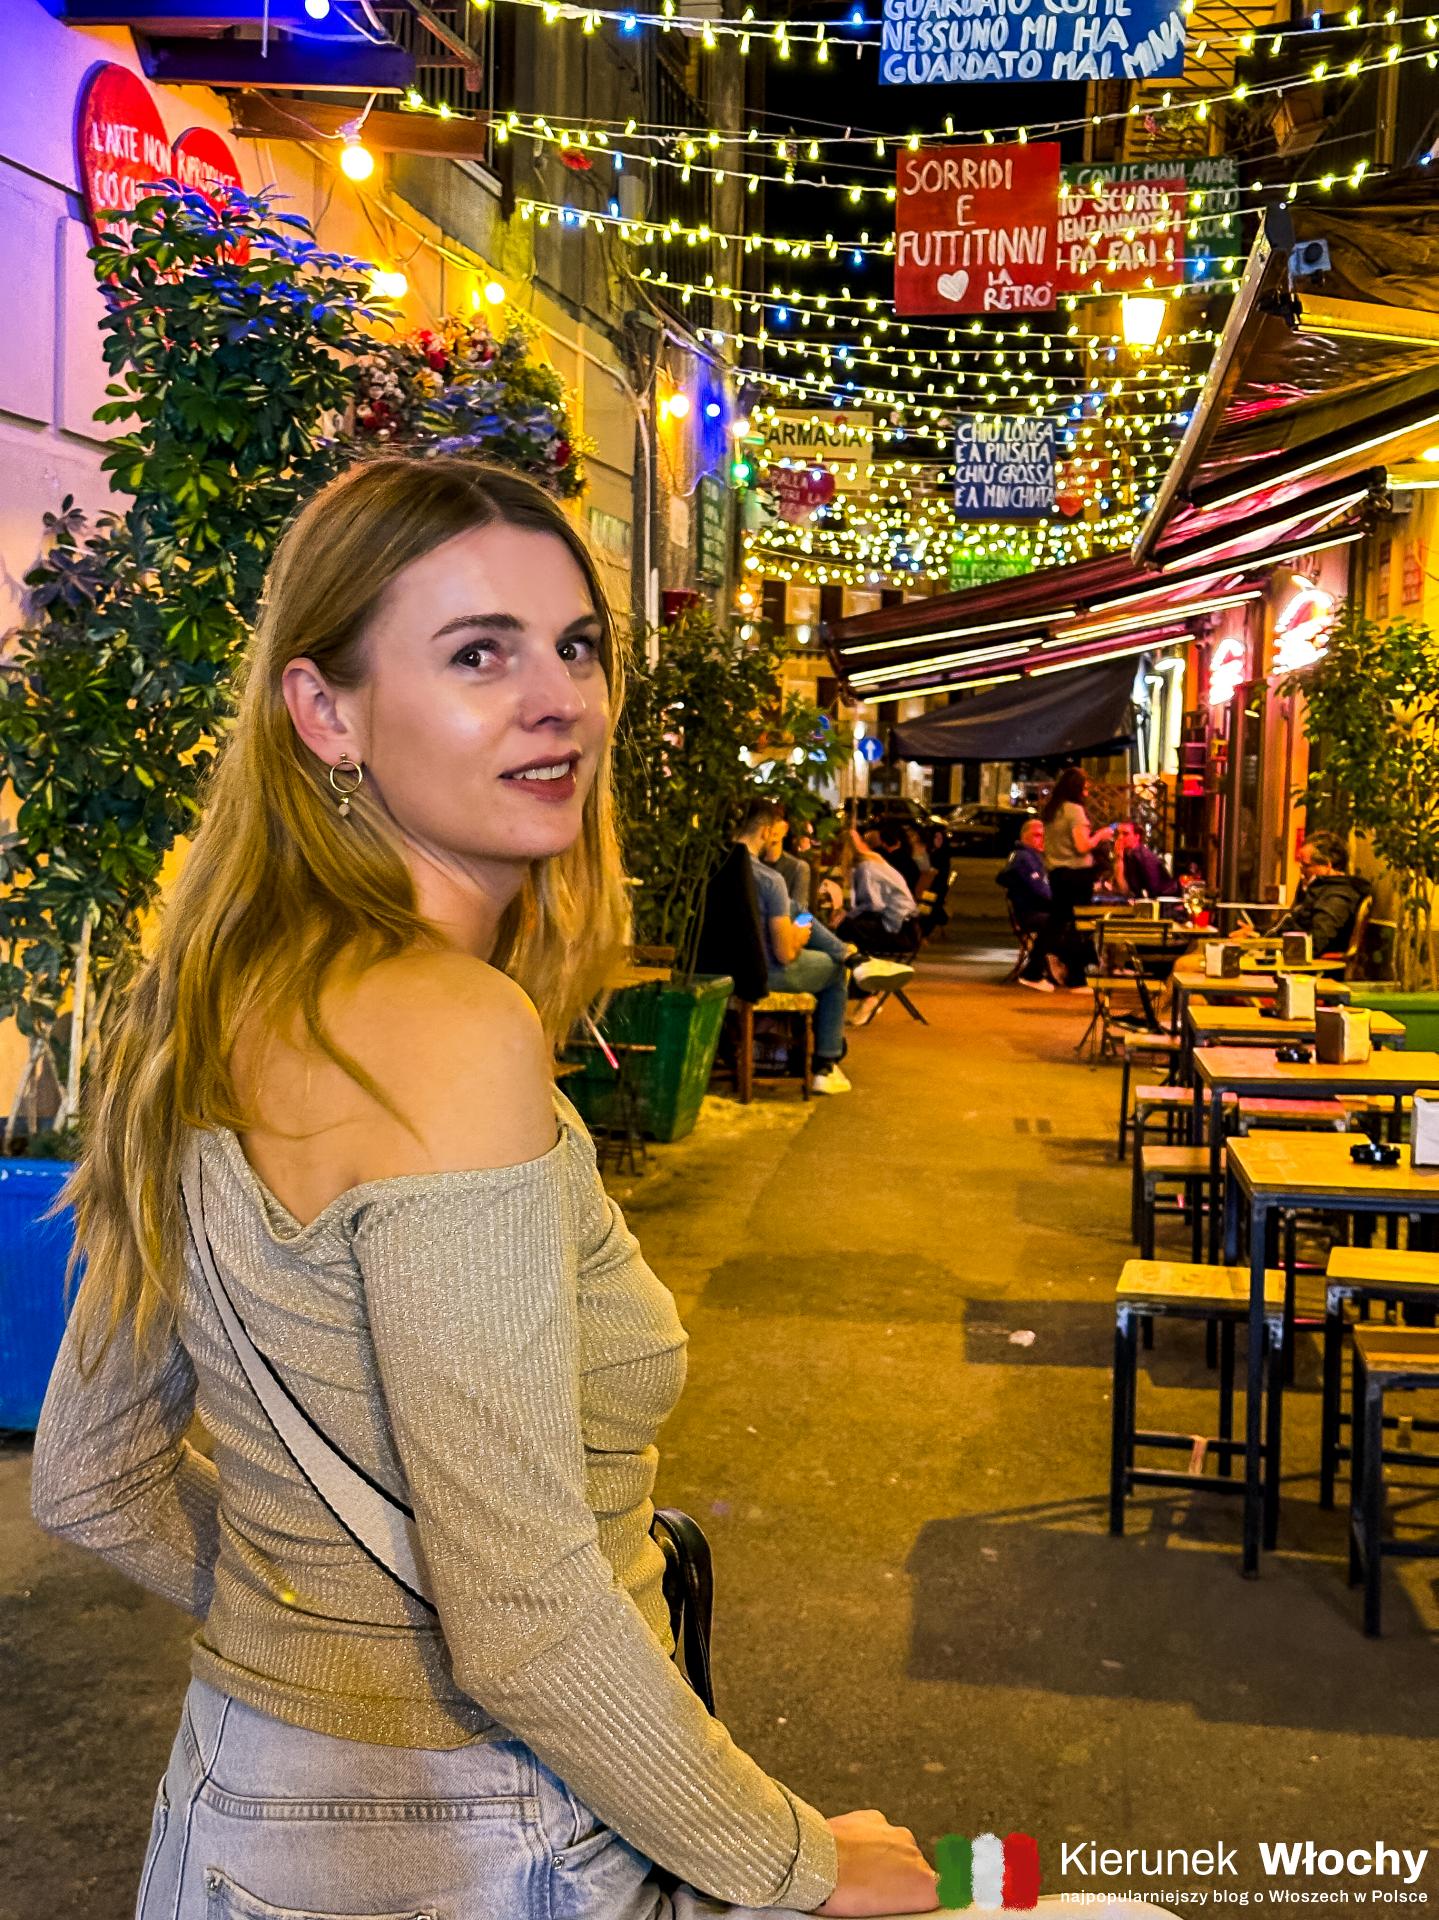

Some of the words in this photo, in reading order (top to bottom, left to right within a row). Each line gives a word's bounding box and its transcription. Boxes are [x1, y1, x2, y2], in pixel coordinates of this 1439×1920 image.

[881, 15, 1010, 53] NESSUNO
[1020, 14, 1058, 51] MI
[1073, 16, 1130, 52] HA
[883, 49, 1043, 84] GUARDATO
[143, 133, 172, 177] NON
[902, 158, 1014, 196] SORRIDI
[956, 194, 977, 227] E
[897, 225, 1048, 268] FUTTITINNI
[987, 268, 1014, 287] LA
[983, 282, 1054, 311] RETRÒ
[757, 423, 863, 448] FARMACIA
[1003, 421, 1055, 443] LONGA
[969, 443, 982, 463] A
[985, 442, 1051, 464] PINSATA
[999, 464, 1055, 486] GROSSA
[966, 486, 980, 509] A
